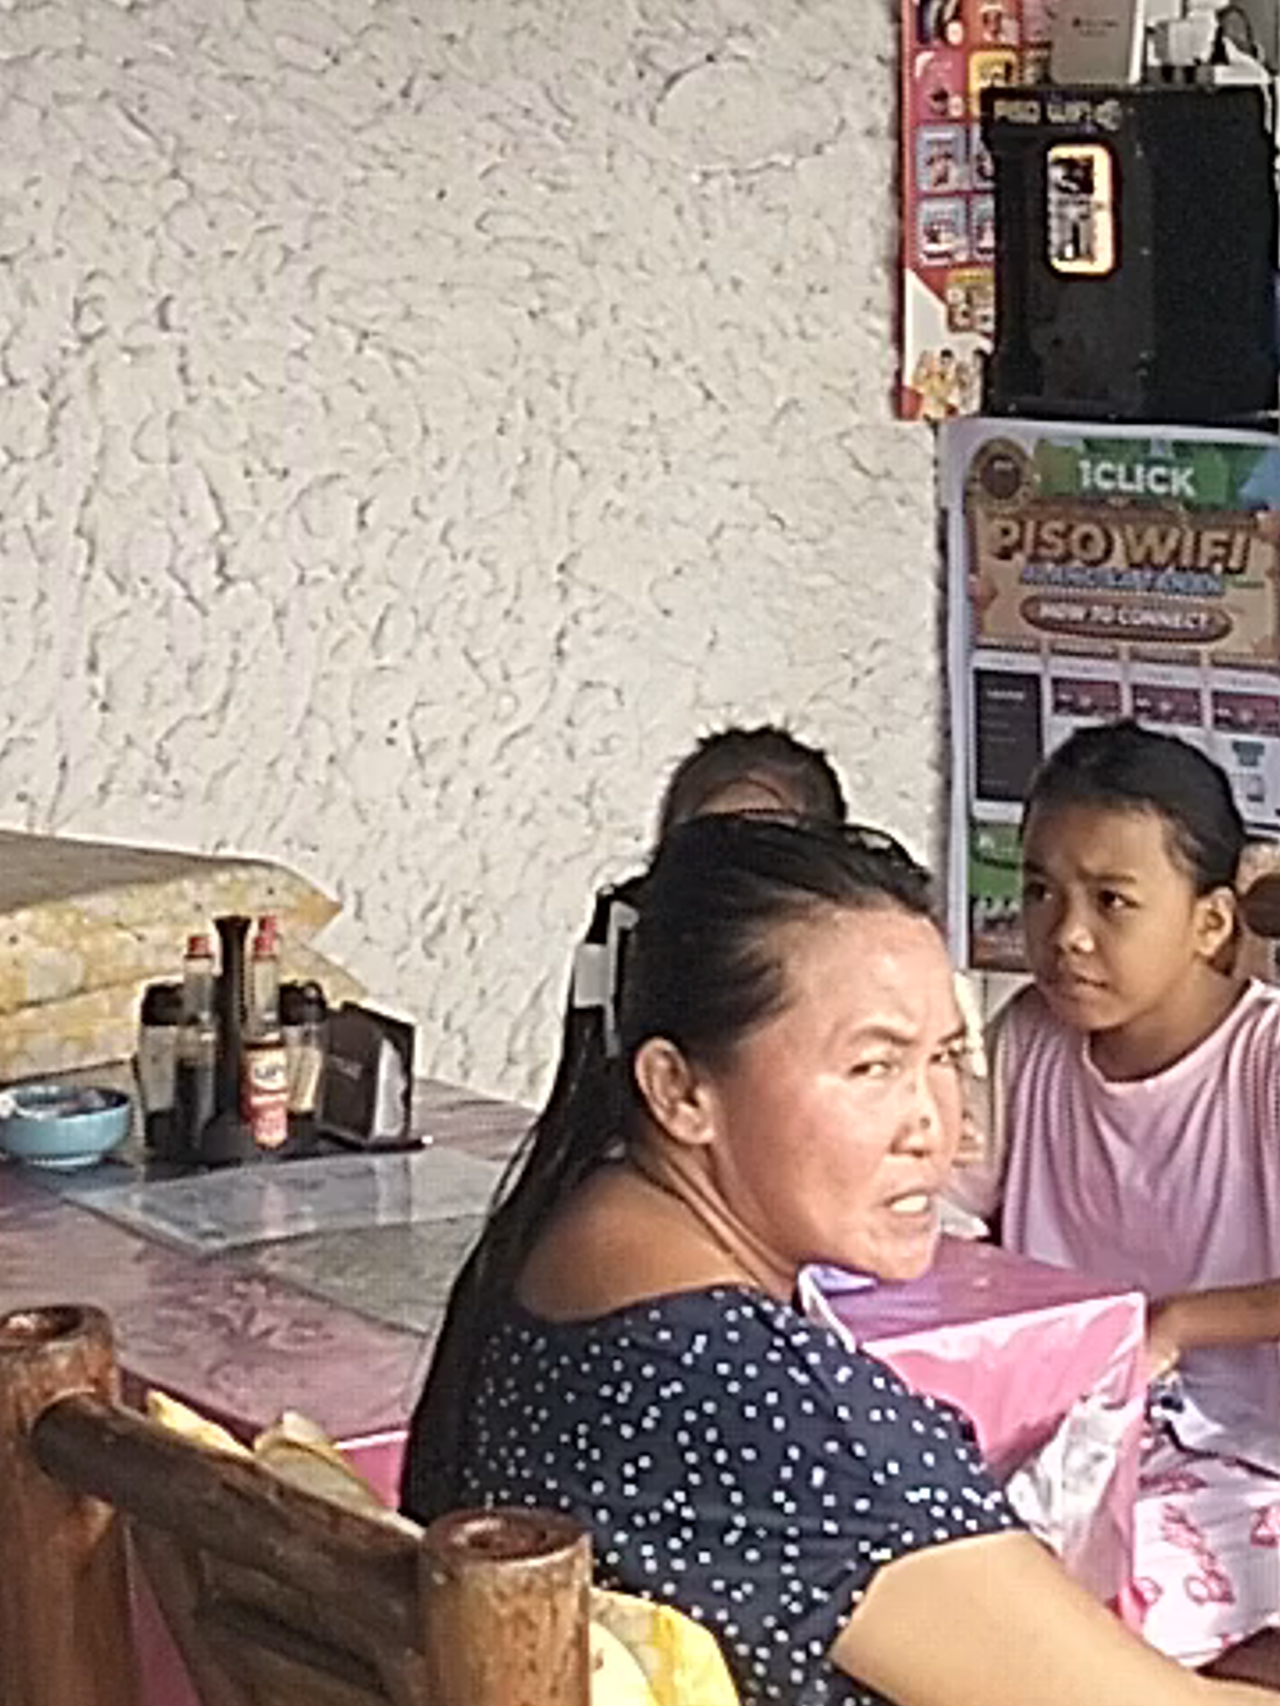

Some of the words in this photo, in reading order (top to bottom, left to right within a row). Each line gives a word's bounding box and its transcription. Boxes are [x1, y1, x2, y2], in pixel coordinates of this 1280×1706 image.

[1078, 458, 1197, 497] 1CLICK
[990, 519, 1115, 567] PISO
[1123, 523, 1252, 575] WIFI
